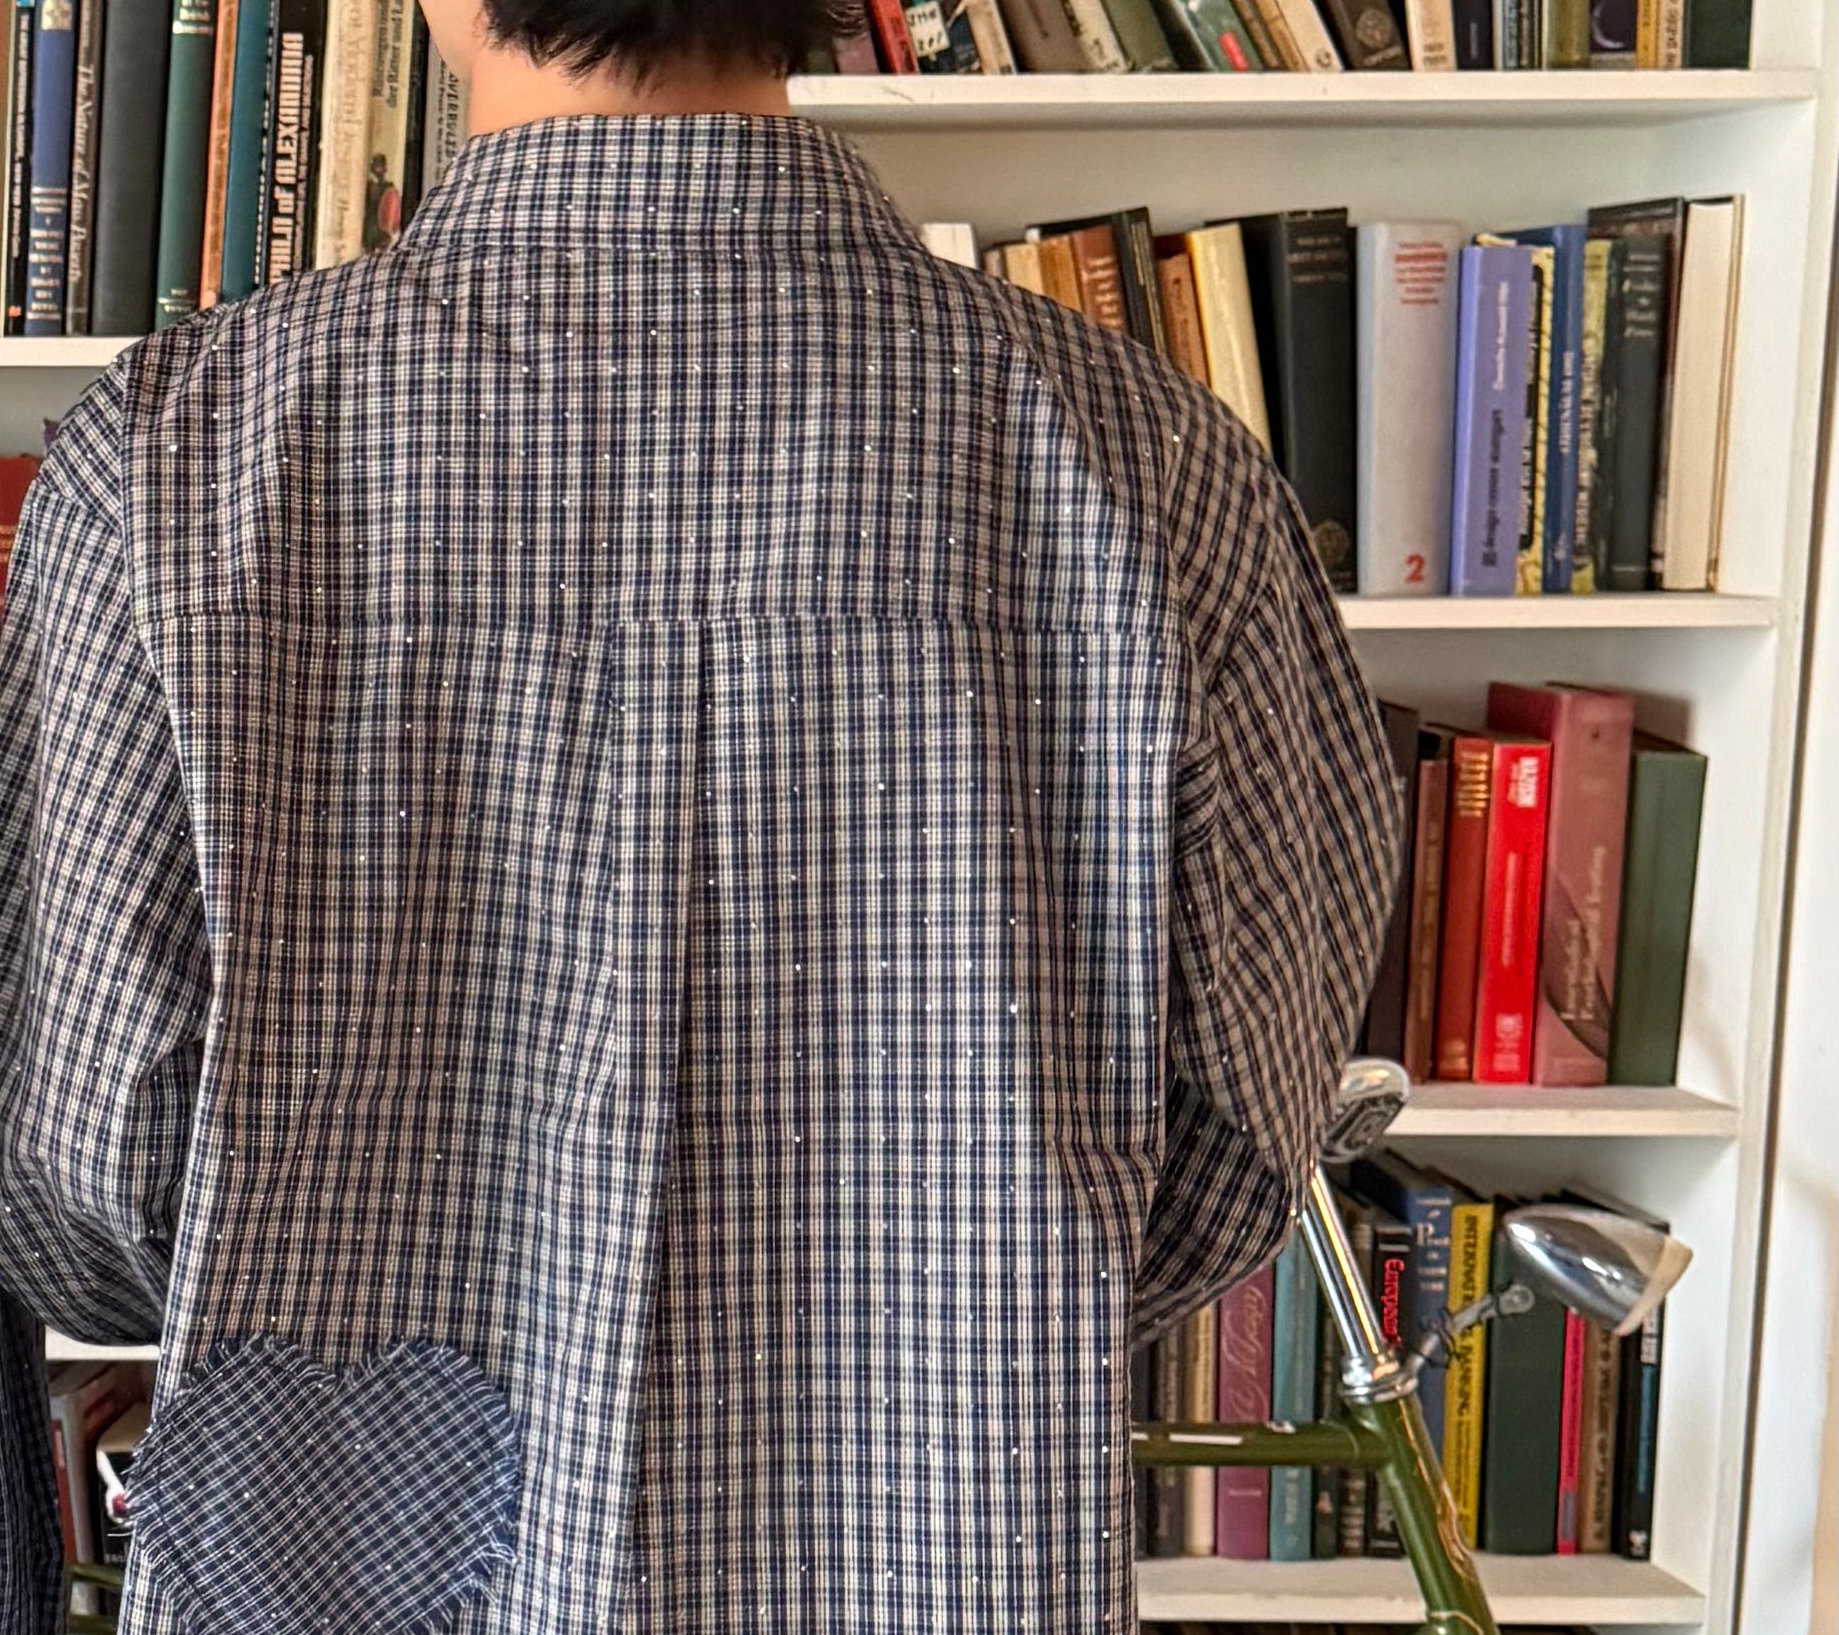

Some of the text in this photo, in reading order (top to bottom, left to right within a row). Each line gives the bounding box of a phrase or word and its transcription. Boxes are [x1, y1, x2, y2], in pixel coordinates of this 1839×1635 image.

[66, 63, 94, 284] The Nature of Mass Poverty
[1405, 554, 1427, 584] 2
